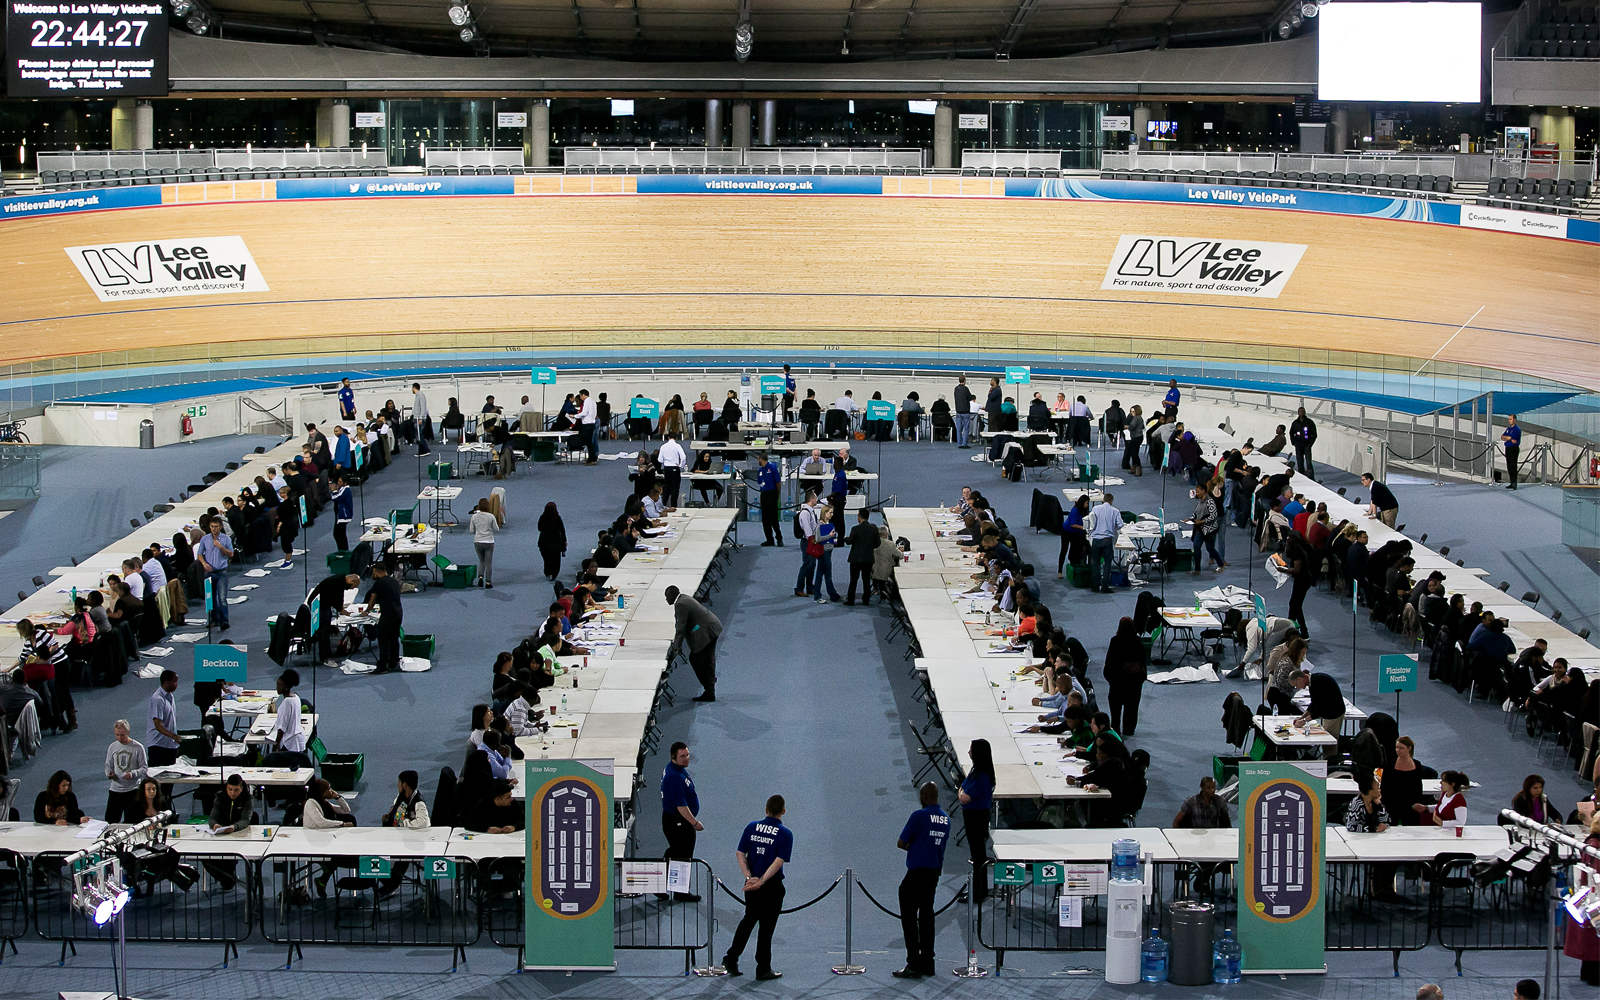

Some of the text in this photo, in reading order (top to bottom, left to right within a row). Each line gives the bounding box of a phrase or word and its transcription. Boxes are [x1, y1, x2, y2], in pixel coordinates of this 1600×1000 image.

[13, 4, 162, 16] Welcome to Lee Valley VeloPark
[31, 20, 149, 47] 22:44:27
[18, 59, 48, 69] Please
[366, 182, 442, 194] @LeeValleyVP
[705, 180, 813, 191] visitleevalley.org.uk
[4, 195, 99, 213] visitleevalley.org.uk
[1188, 188, 1297, 205] Lee Valley VeloPark
[153, 244, 209, 262] Lee
[1117, 239, 1211, 277] LV
[1204, 242, 1262, 262] Lee
[81, 245, 153, 287] LV
[163, 261, 246, 281] Valley
[1199, 261, 1284, 286] Valley
[104, 281, 245, 297] For nature, sport and discovery
[1113, 278, 1261, 294] For nature, sport and discovery
[202, 659, 239, 667] Beckton
[930, 814, 949, 825] WISE
[755, 823, 780, 836] WISE
[750, 834, 775, 845] SECURITY
